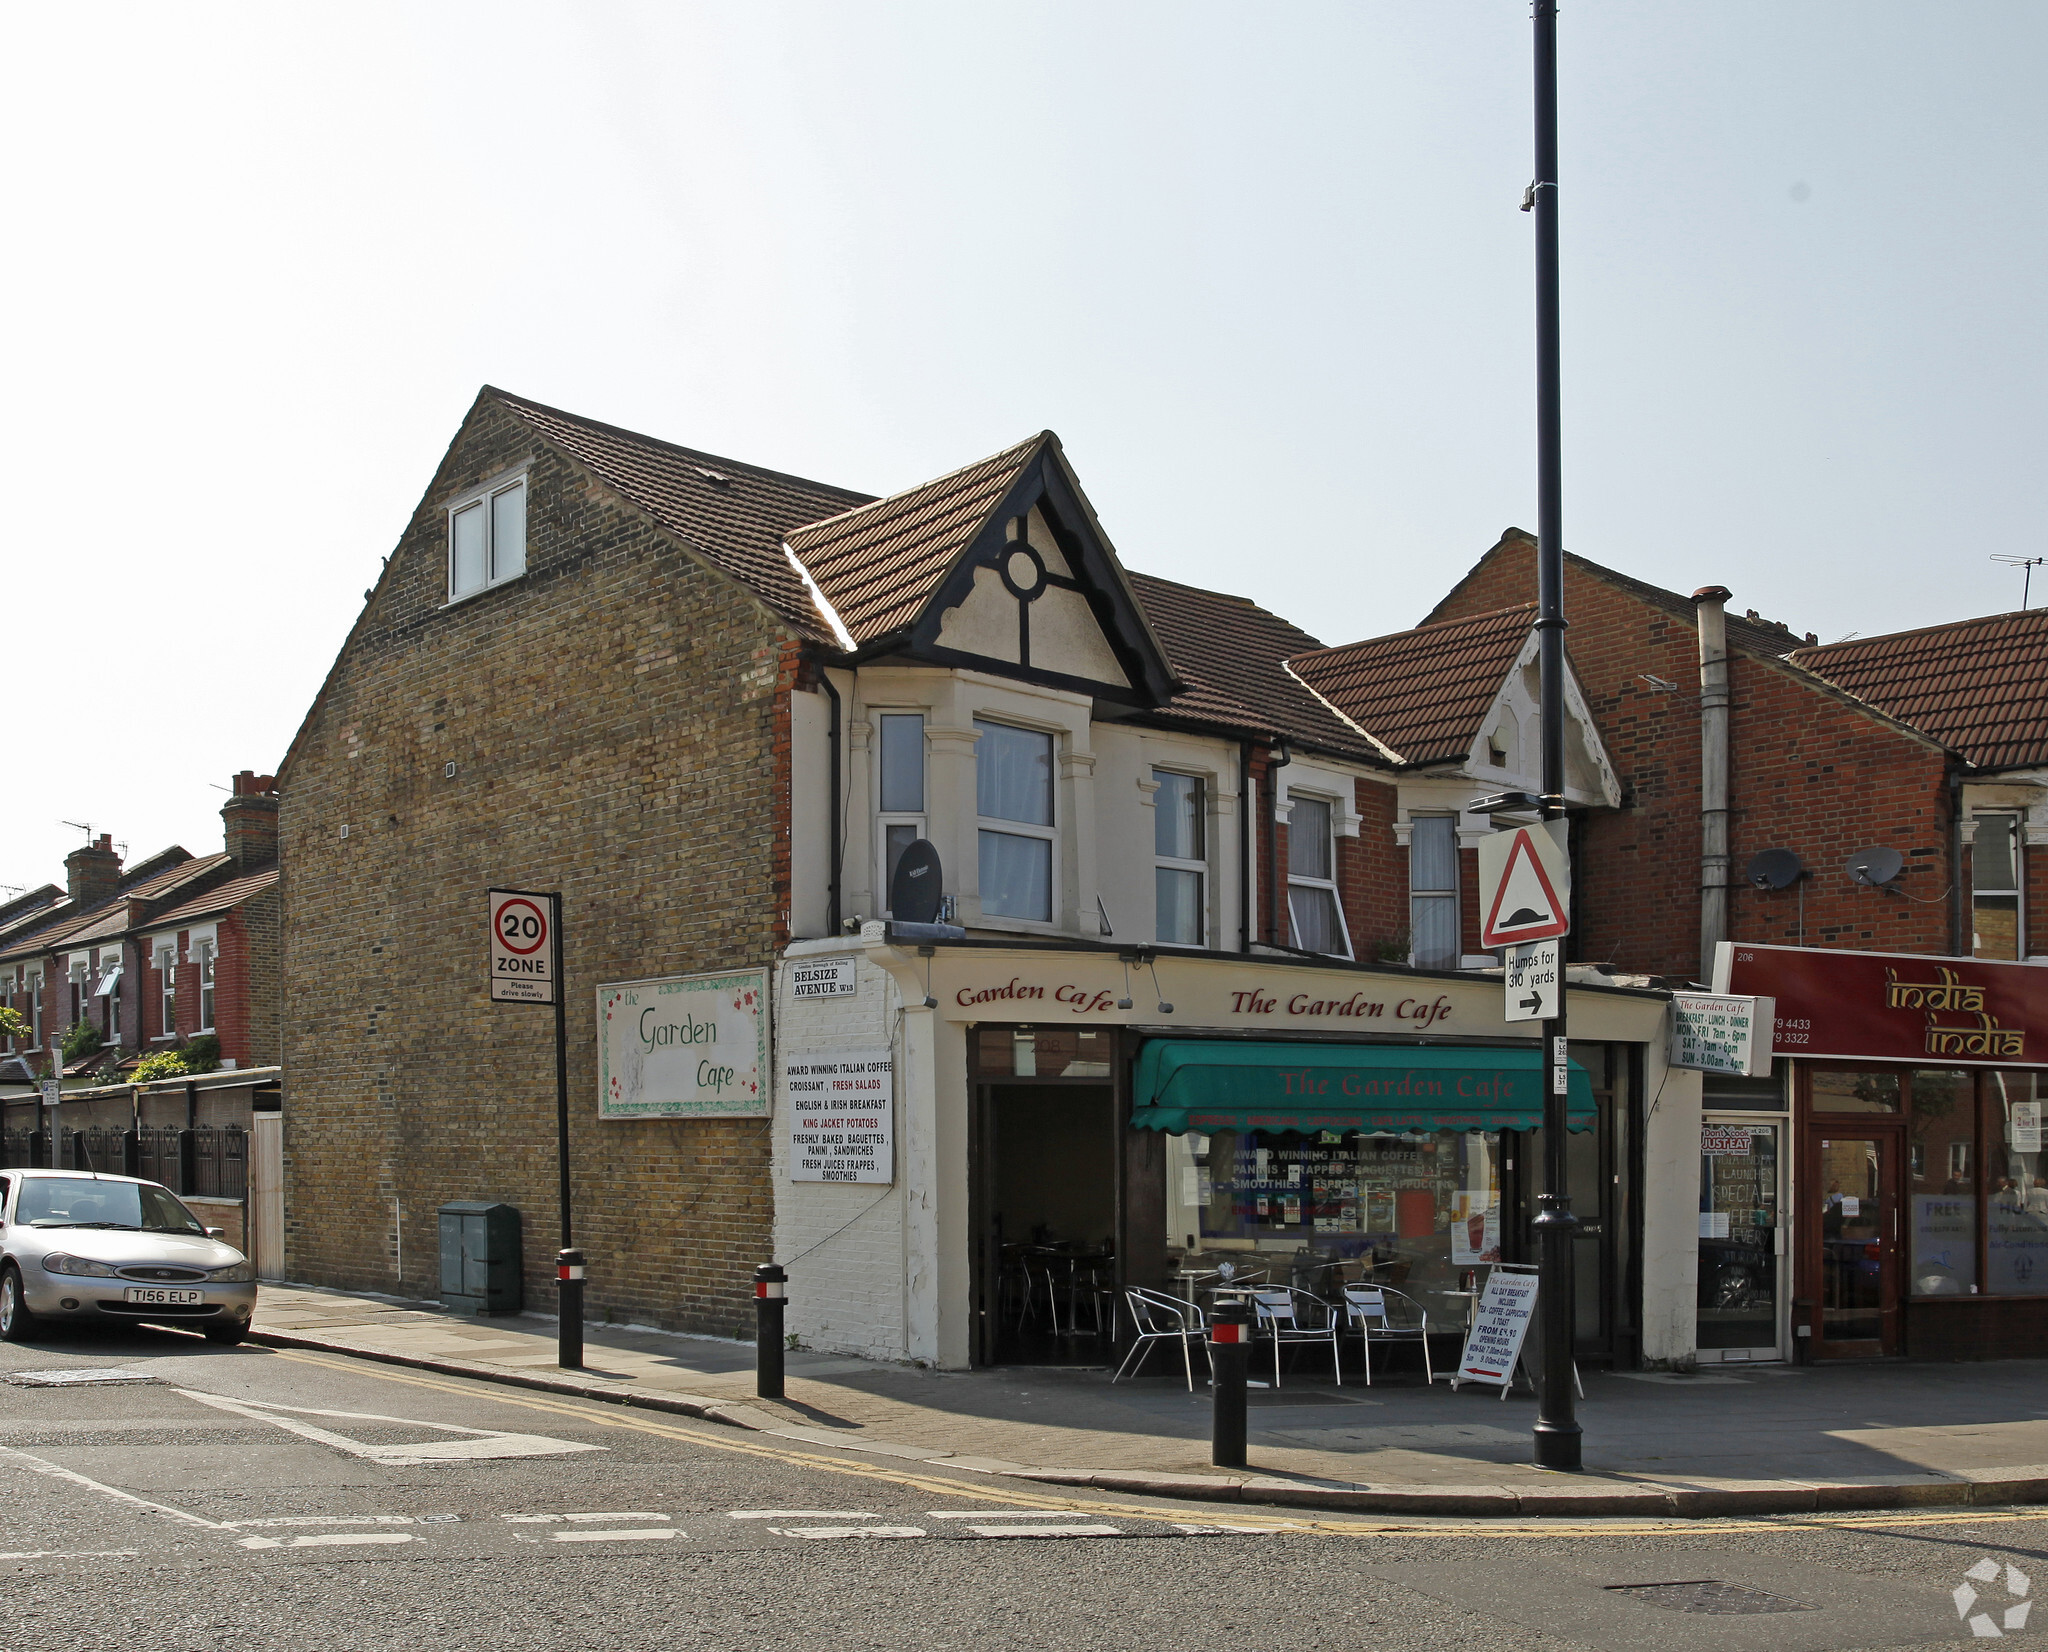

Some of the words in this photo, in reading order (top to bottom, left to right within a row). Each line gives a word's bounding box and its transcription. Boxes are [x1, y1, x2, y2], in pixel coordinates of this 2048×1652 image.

[504, 914, 539, 939] 20
[1508, 955, 1538, 970] Humps
[1541, 951, 1554, 964] for
[1738, 953, 1754, 962] 206
[498, 957, 545, 974] ZONE
[794, 969, 838, 982] BELSIZE
[1509, 973, 1524, 988] 310
[1530, 969, 1555, 988] yards
[511, 982, 534, 990] Please
[794, 982, 837, 995] AVENUE
[839, 984, 853, 992] W13
[1886, 966, 1986, 1011] india
[521, 990, 543, 998] slowly
[624, 990, 639, 1006] the
[956, 977, 1044, 1006] Garden
[1055, 985, 1114, 1013] Cafe
[1231, 988, 1277, 1014] The
[1288, 992, 1384, 1018] Garden
[1396, 995, 1452, 1030] Cafe
[1680, 1000, 1693, 1010] The
[1696, 1000, 1723, 1011] Garden
[1726, 1001, 1745, 1016] Cafe
[1675, 1011, 1704, 1024] BREAKFAST
[1708, 1014, 1725, 1026] LUNCH
[1730, 1017, 1749, 1028] DINNER
[1786, 1019, 1811, 1030] 4433
[640, 1007, 717, 1054] Garden
[1676, 1024, 1692, 1036] MON
[1697, 1026, 1709, 1037] FRI
[1713, 1028, 1726, 1039] 7am
[1732, 1030, 1746, 1043] 6pm
[1925, 1011, 2025, 1056] india
[1785, 1033, 1809, 1044] 3322
[1682, 1037, 1697, 1049] SAT
[1703, 1041, 1717, 1052] 7am
[1723, 1042, 1738, 1056] 6pm
[1682, 1051, 1695, 1064] SUN
[1701, 1053, 1724, 1066] 9.00am
[1730, 1057, 1744, 1070] 4pm
[787, 1065, 809, 1075] AWARD
[811, 1064, 838, 1074] WINNING
[840, 1063, 865, 1073] ITALIAN
[867, 1061, 892, 1072] COFFEE
[697, 1059, 734, 1094] Cafe
[789, 1081, 824, 1091] CROISSANT
[832, 1080, 853, 1090] FRESH
[855, 1079, 881, 1090] SALADS
[1279, 1069, 1329, 1095] The
[1342, 1070, 1443, 1097] Garden
[1457, 1072, 1514, 1107] Cafe
[795, 1100, 822, 1110] ENGLISH
[823, 1101, 829, 1110] &
[831, 1100, 847, 1110] IRISH
[849, 1099, 886, 1110] BREAKFAST
[803, 1118, 818, 1128] KING
[820, 1118, 845, 1128] JACKET
[846, 1118, 878, 1128] POTATOES
[1396, 1115, 1424, 1126] LATTE
[2017, 1116, 2021, 1126] 2
[793, 1134, 819, 1144] FRESHLY
[822, 1134, 844, 1144] BAKED
[847, 1134, 885, 1144] BAGUETTES
[1730, 1129, 1749, 1137] cook
[1702, 1138, 1728, 1149] JUST
[1729, 1139, 1750, 1149] EAT
[808, 1146, 828, 1155] PANINI
[834, 1146, 874, 1156] SANDWICHES
[1232, 1150, 1274, 1160] AWAD
[1278, 1150, 1328, 1160] WINNING
[1333, 1151, 1377, 1160] ITALIAN
[1381, 1151, 1423, 1160] COFFEE
[802, 1159, 821, 1169] FRESH
[823, 1160, 845, 1170] JUICES
[846, 1160, 875, 1170] FRAPPES
[1233, 1165, 1278, 1174] PANNIS
[1296, 1165, 1343, 1174] RAPPES
[822, 1171, 857, 1181] SMOOTHIES
[1722, 1168, 1773, 1181] LAUNCHES
[1232, 1179, 1301, 1189] SMOOTHIES
[1313, 1179, 1371, 1189] ESPRESSO
[1713, 1184, 1772, 1206] SPECIAL
[1926, 1202, 1961, 1216] FREE
[1732, 1227, 1769, 1248] EVERY
[1489, 1277, 1498, 1285] The
[1500, 1278, 1520, 1286] Garden
[133, 1290, 165, 1302] T156
[169, 1291, 197, 1303] ELP
[1491, 1287, 1499, 1295] ALL
[1499, 1287, 1507, 1296] DAY
[1507, 1288, 1529, 1298] BREAKFAST
[1497, 1297, 1517, 1307] INCLUDES
[1488, 1306, 1504, 1316] COFFEE
[1505, 1308, 1529, 1318] CAPPUCCINO
[1497, 1318, 1510, 1326] TOAST
[1477, 1325, 1498, 1334] FROM
[1479, 1335, 1496, 1344] OPENING
[1496, 1337, 1510, 1346] HOURS
